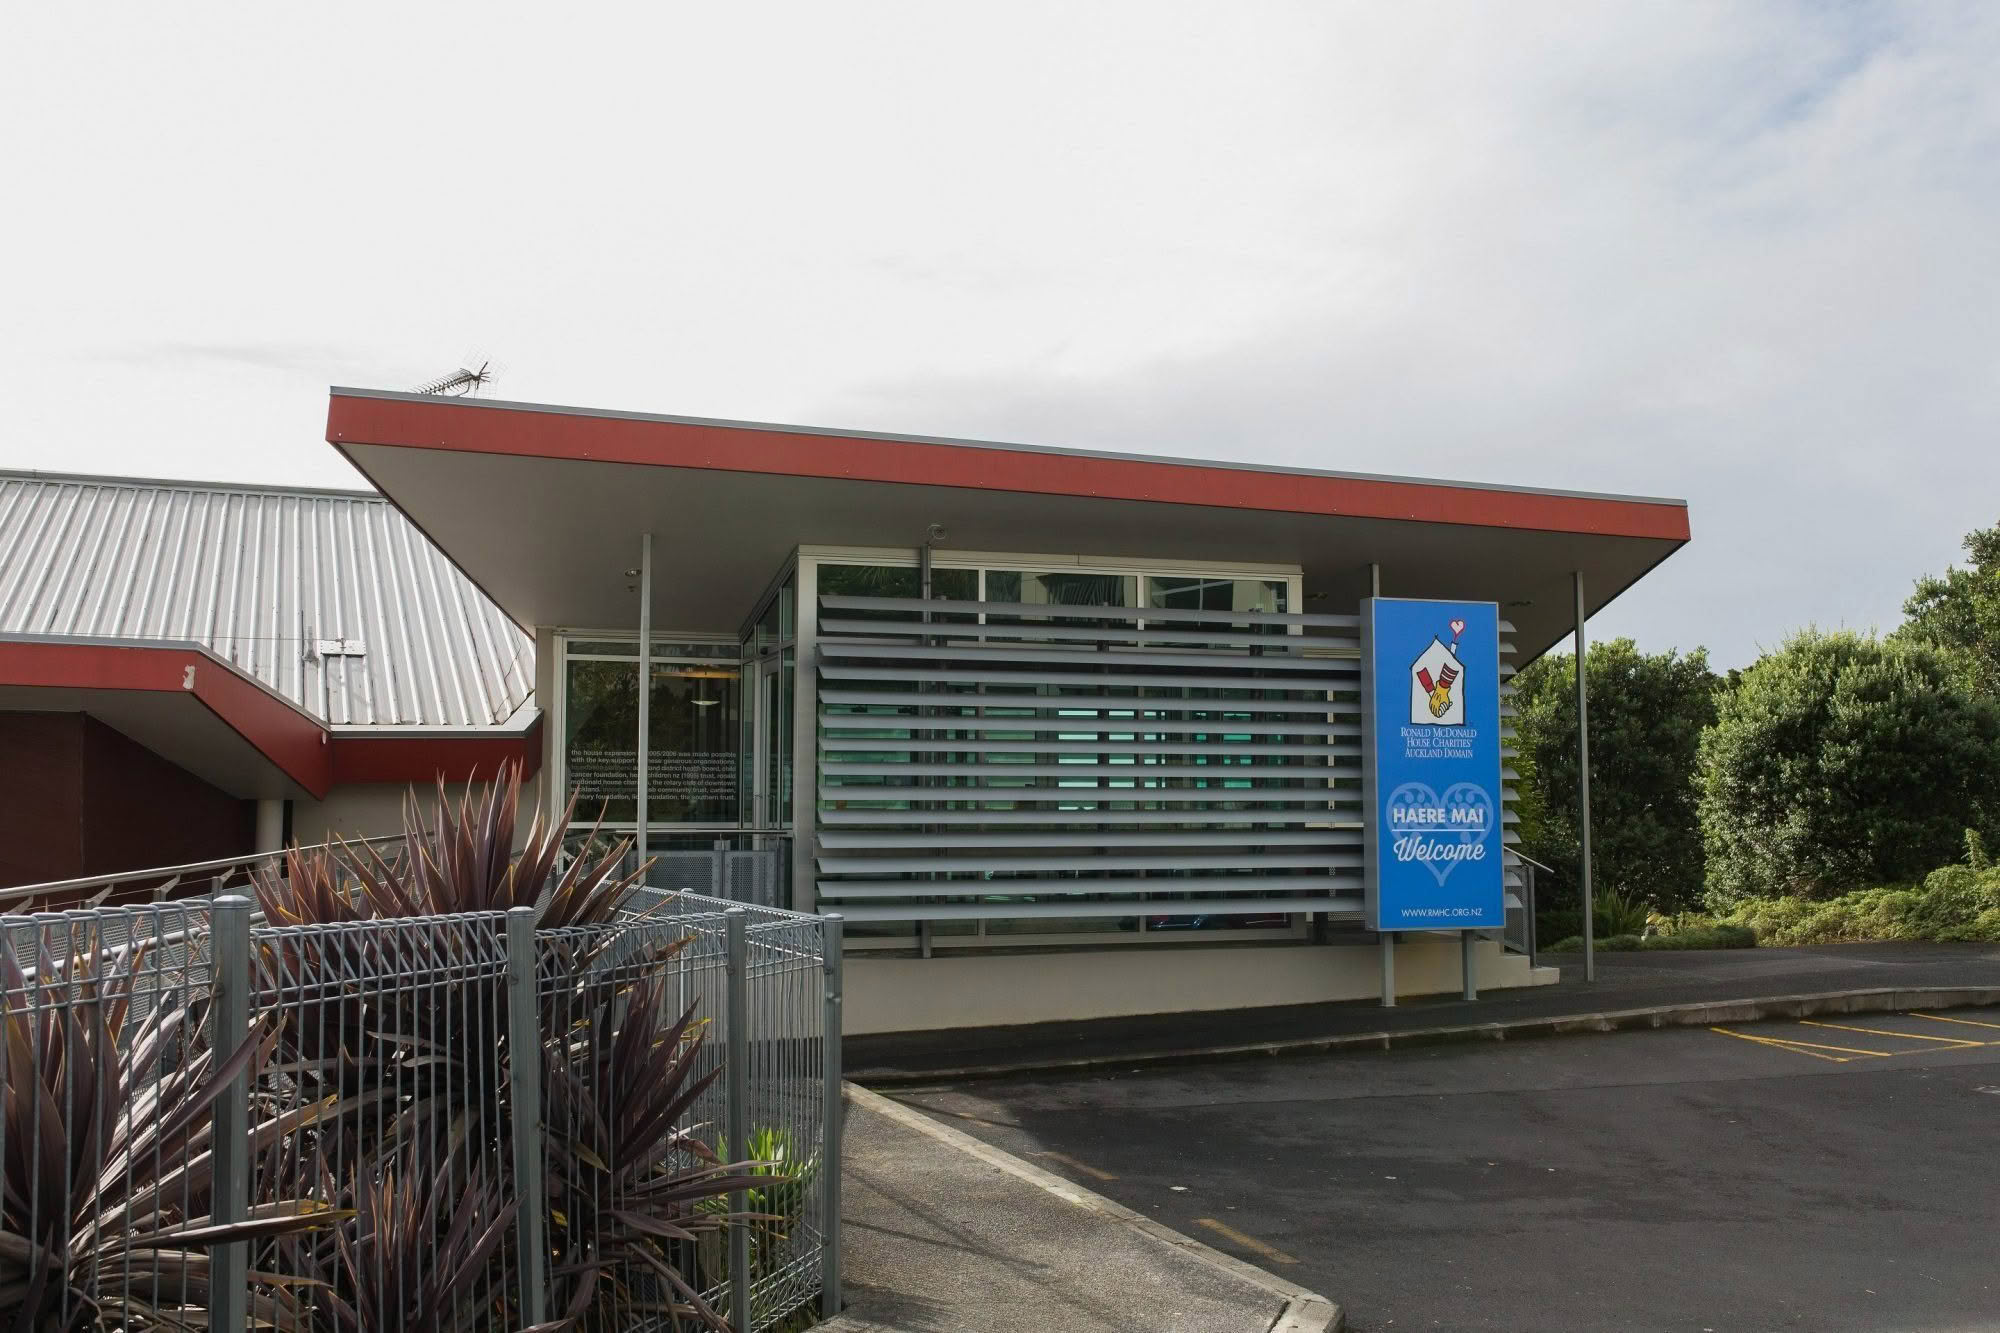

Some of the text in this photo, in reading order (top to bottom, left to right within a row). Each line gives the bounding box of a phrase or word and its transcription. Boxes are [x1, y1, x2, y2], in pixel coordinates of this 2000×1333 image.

[1400, 727, 1431, 738] RONALD
[1407, 737, 1431, 748] HOUSE
[1405, 748, 1473, 758] AUCKLAND DOMAIN
[1393, 808, 1484, 823] HAERE MAI
[1393, 836, 1486, 862] Welcome
[1401, 907, 1483, 918] WWW.RMHC.ORG.NZ
